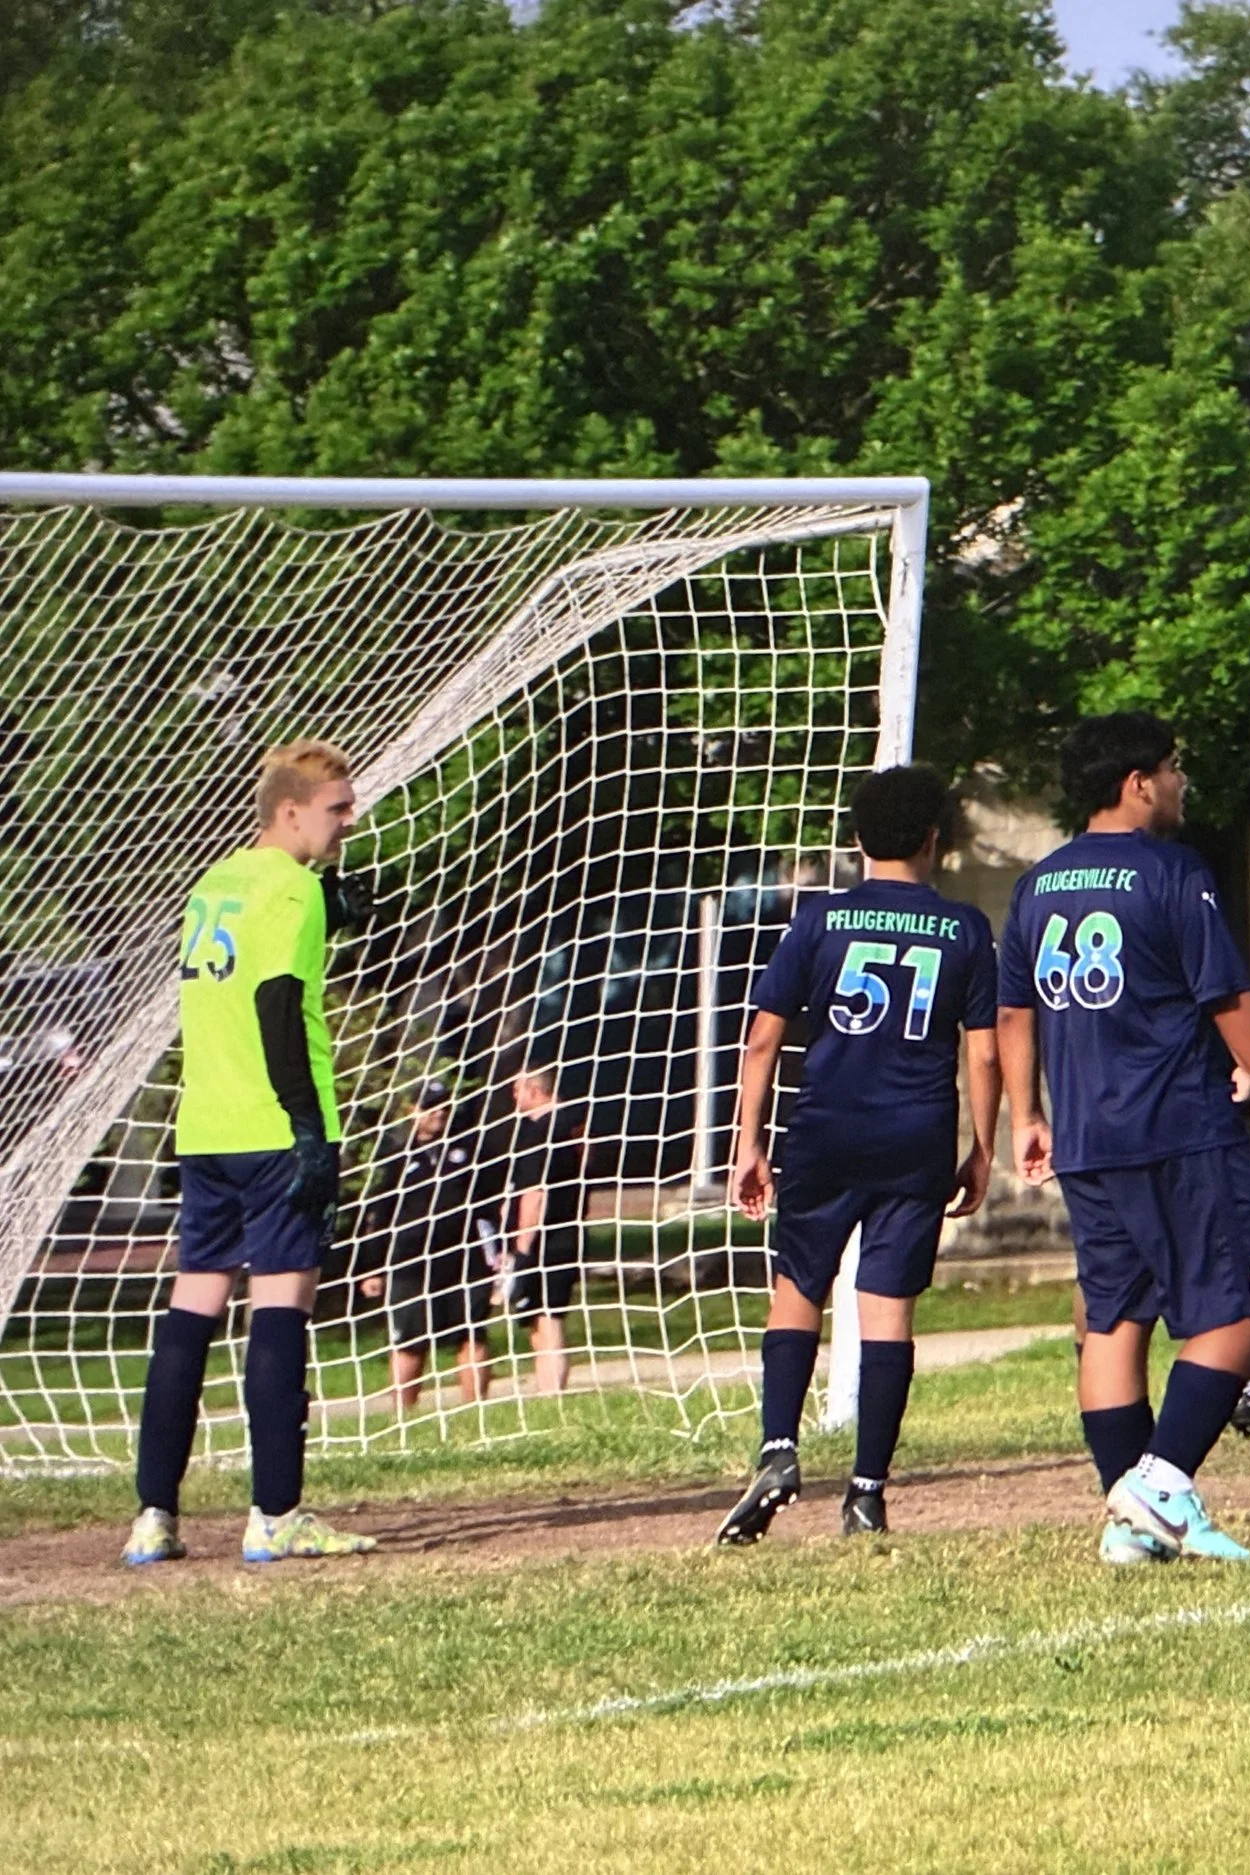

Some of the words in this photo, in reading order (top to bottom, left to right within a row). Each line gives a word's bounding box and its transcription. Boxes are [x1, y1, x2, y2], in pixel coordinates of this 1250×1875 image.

[1115, 869, 1137, 892] FC
[181, 898, 243, 982] 25
[826, 909, 938, 936] PFLUGERVILLE
[939, 917, 960, 940] FC
[1034, 911, 1124, 1011] 68
[829, 941, 942, 1040] 51
